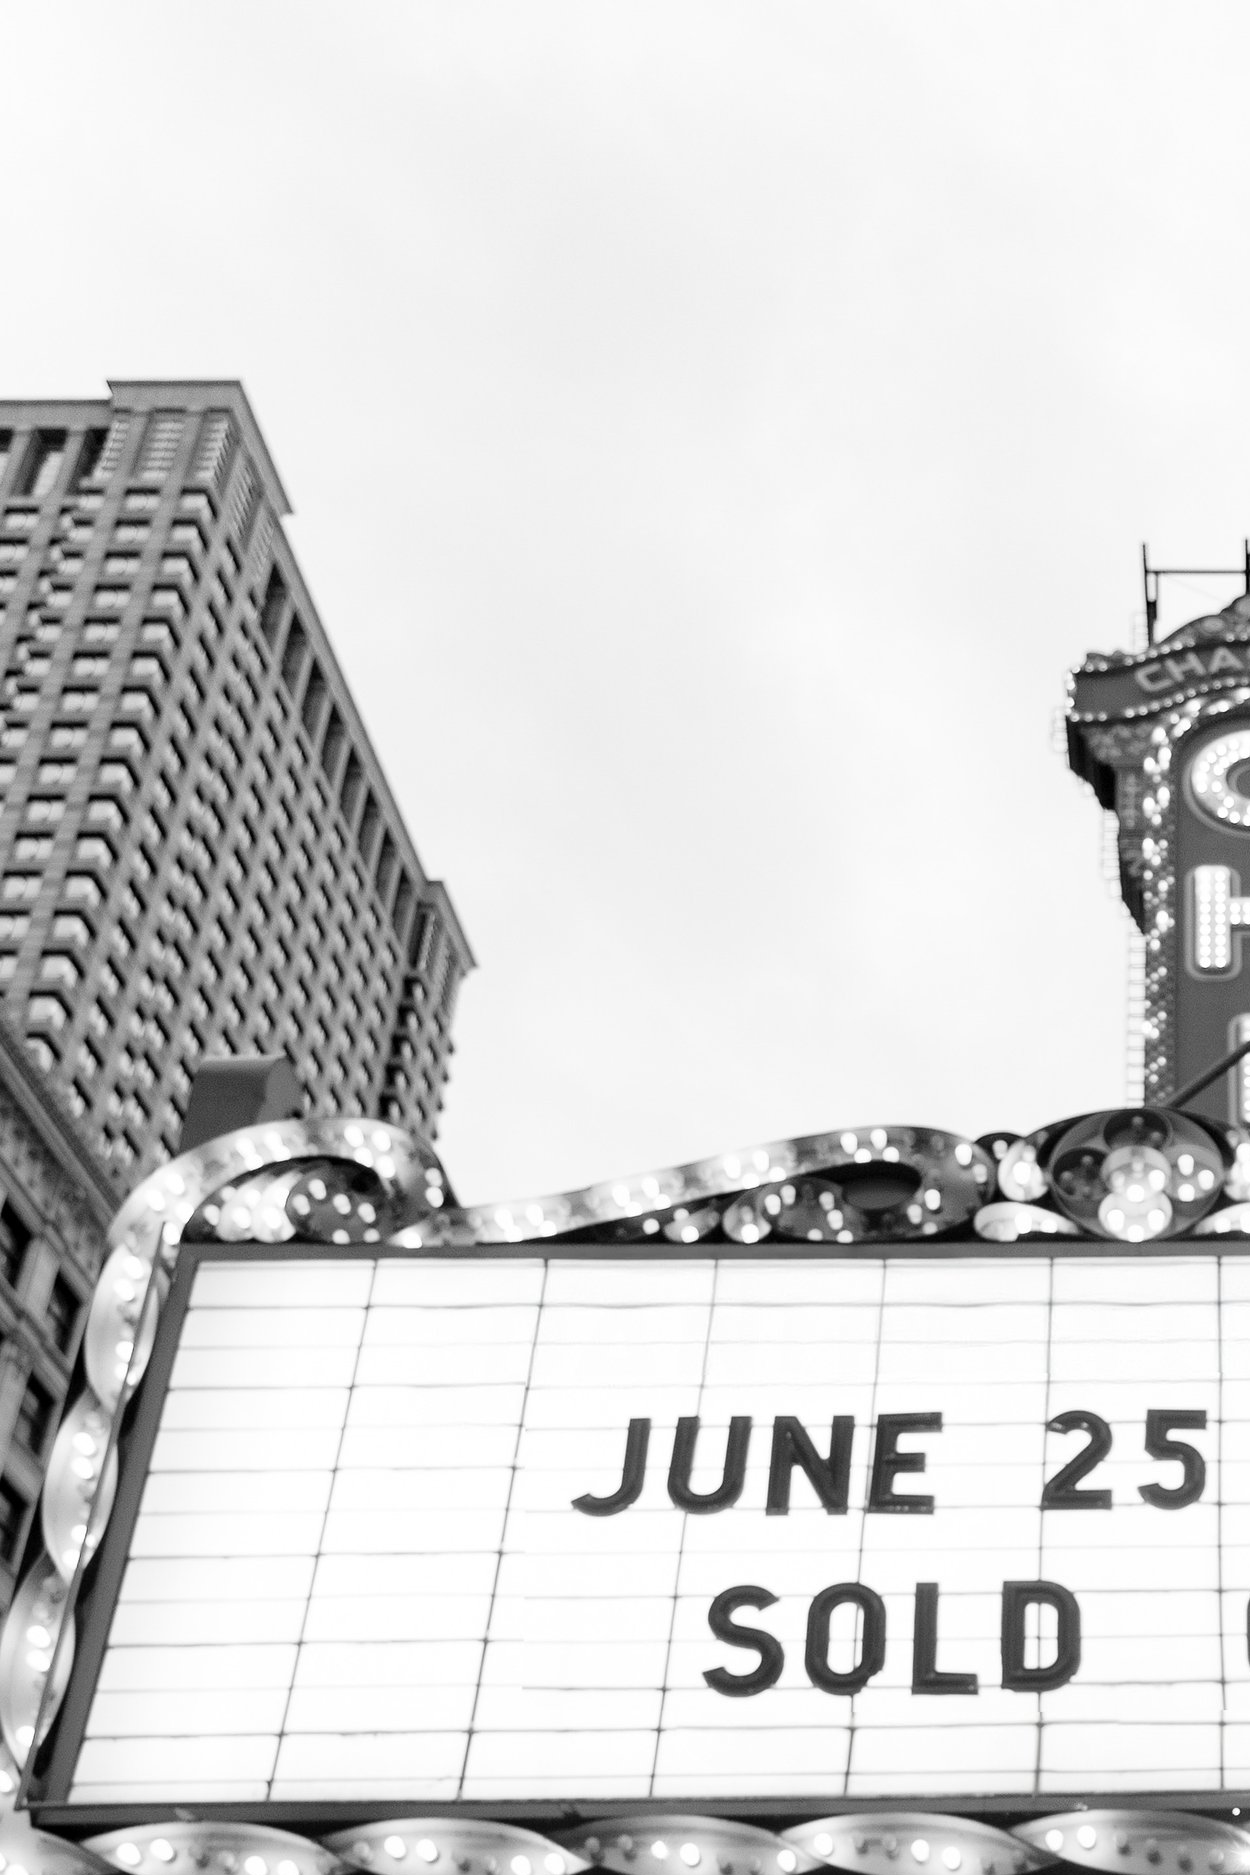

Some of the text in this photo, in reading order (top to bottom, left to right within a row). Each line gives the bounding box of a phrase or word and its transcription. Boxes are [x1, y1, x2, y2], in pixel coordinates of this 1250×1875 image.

[571, 1412, 942, 1515] JUNE
[1041, 1410, 1206, 1509] 25
[703, 1580, 1081, 1697] SOLD
